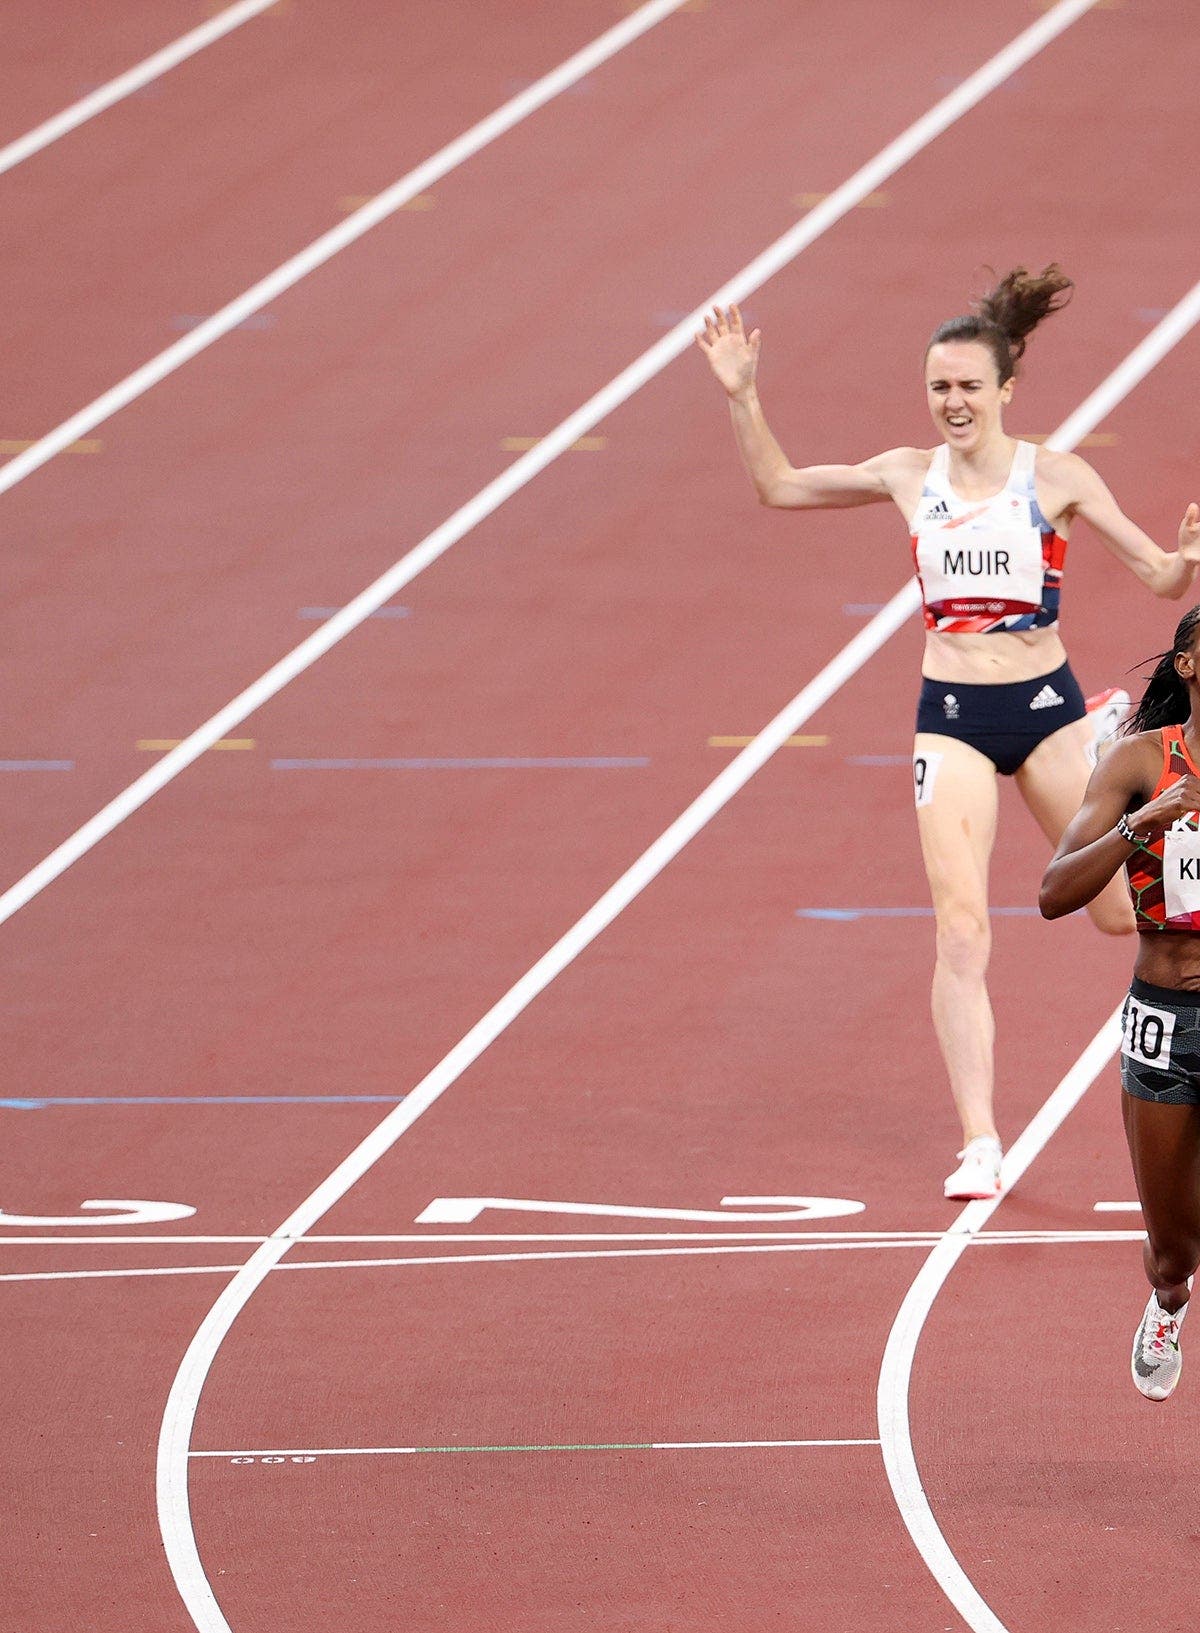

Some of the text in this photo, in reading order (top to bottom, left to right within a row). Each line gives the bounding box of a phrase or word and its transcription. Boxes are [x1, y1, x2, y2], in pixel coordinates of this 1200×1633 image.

[943, 550, 1011, 576] MUIR
[914, 757, 928, 800] 9
[1130, 1006, 1165, 1060] 10
